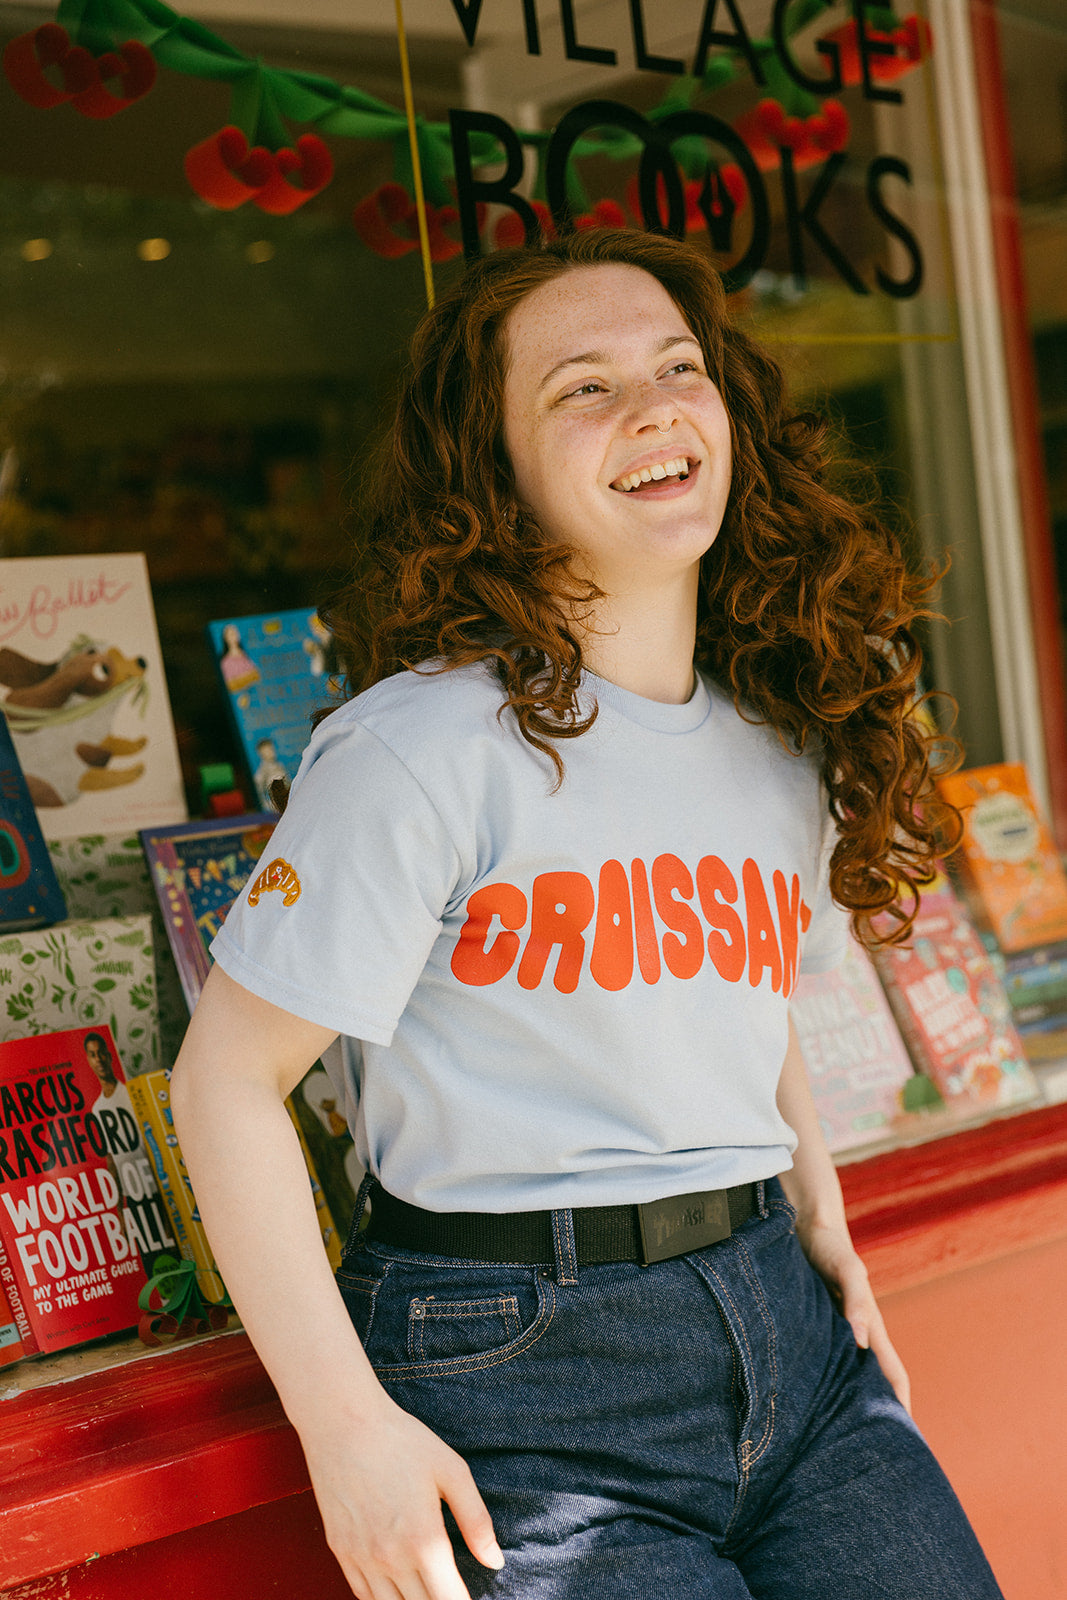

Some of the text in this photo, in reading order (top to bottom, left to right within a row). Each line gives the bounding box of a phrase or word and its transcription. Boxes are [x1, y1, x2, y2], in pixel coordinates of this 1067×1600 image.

[449, 99, 925, 299] BOOKS
[0, 1072, 85, 1130] ARCUS
[0, 1107, 141, 1184] RASHFORD
[1, 1158, 159, 1234] WORLD OF
[15, 1201, 175, 1287] FOOTBALL
[1, 1266, 15, 1283] OF
[33, 1284, 51, 1302] MY
[56, 1268, 109, 1294] ULTIMATE
[111, 1259, 140, 1278] GUIDE
[36, 1282, 114, 1316] TO THE GAME
[6, 1284, 32, 1341] FOOTBALL
